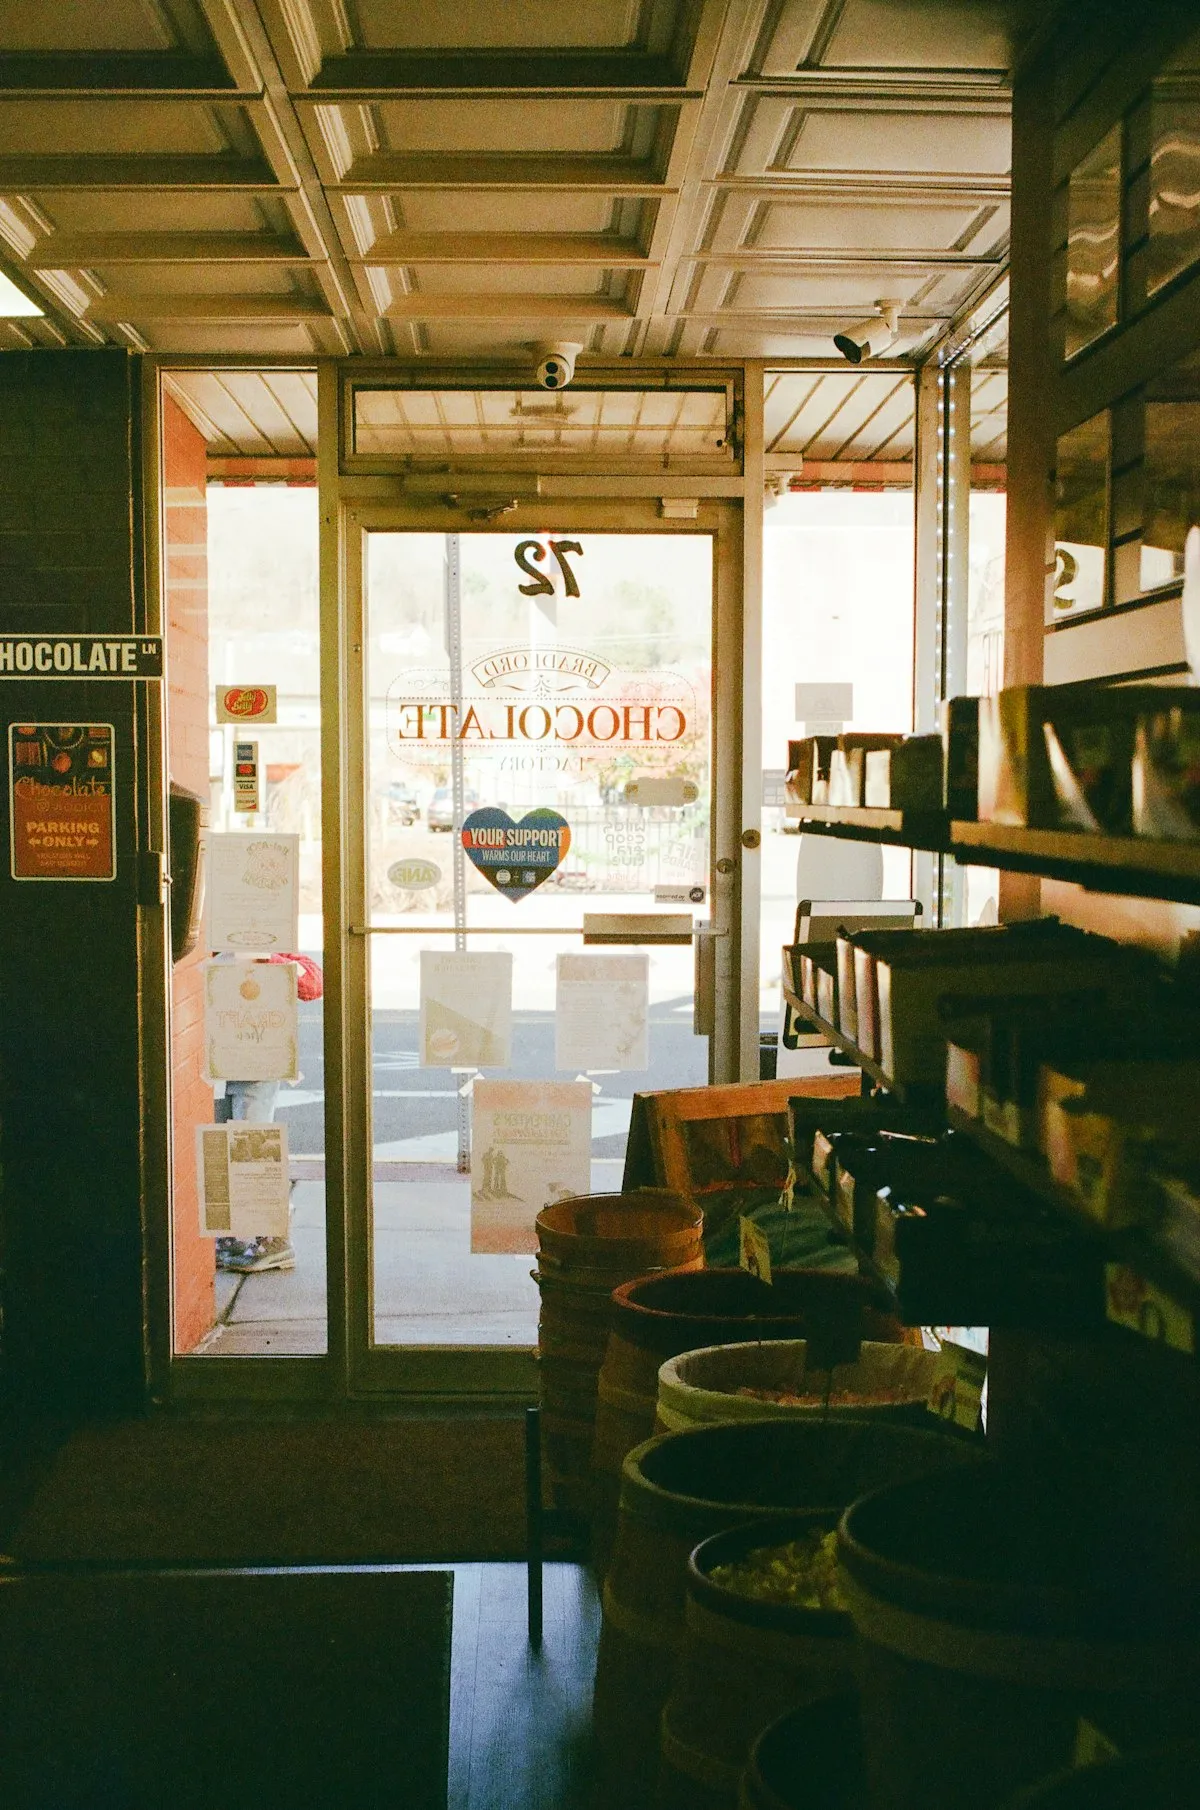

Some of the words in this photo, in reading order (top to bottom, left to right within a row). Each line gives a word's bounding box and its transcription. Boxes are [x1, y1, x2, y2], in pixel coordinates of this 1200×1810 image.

[142, 643, 157, 655] LN
[26, 821, 100, 834] PARKING
[43, 836, 86, 847] ONLY
[470, 828, 504, 846] YOUR
[506, 828, 565, 847] SUPPORT
[481, 849, 510, 861] WARMS
[511, 850, 526, 862] OUR
[527, 850, 551, 862] HEART
